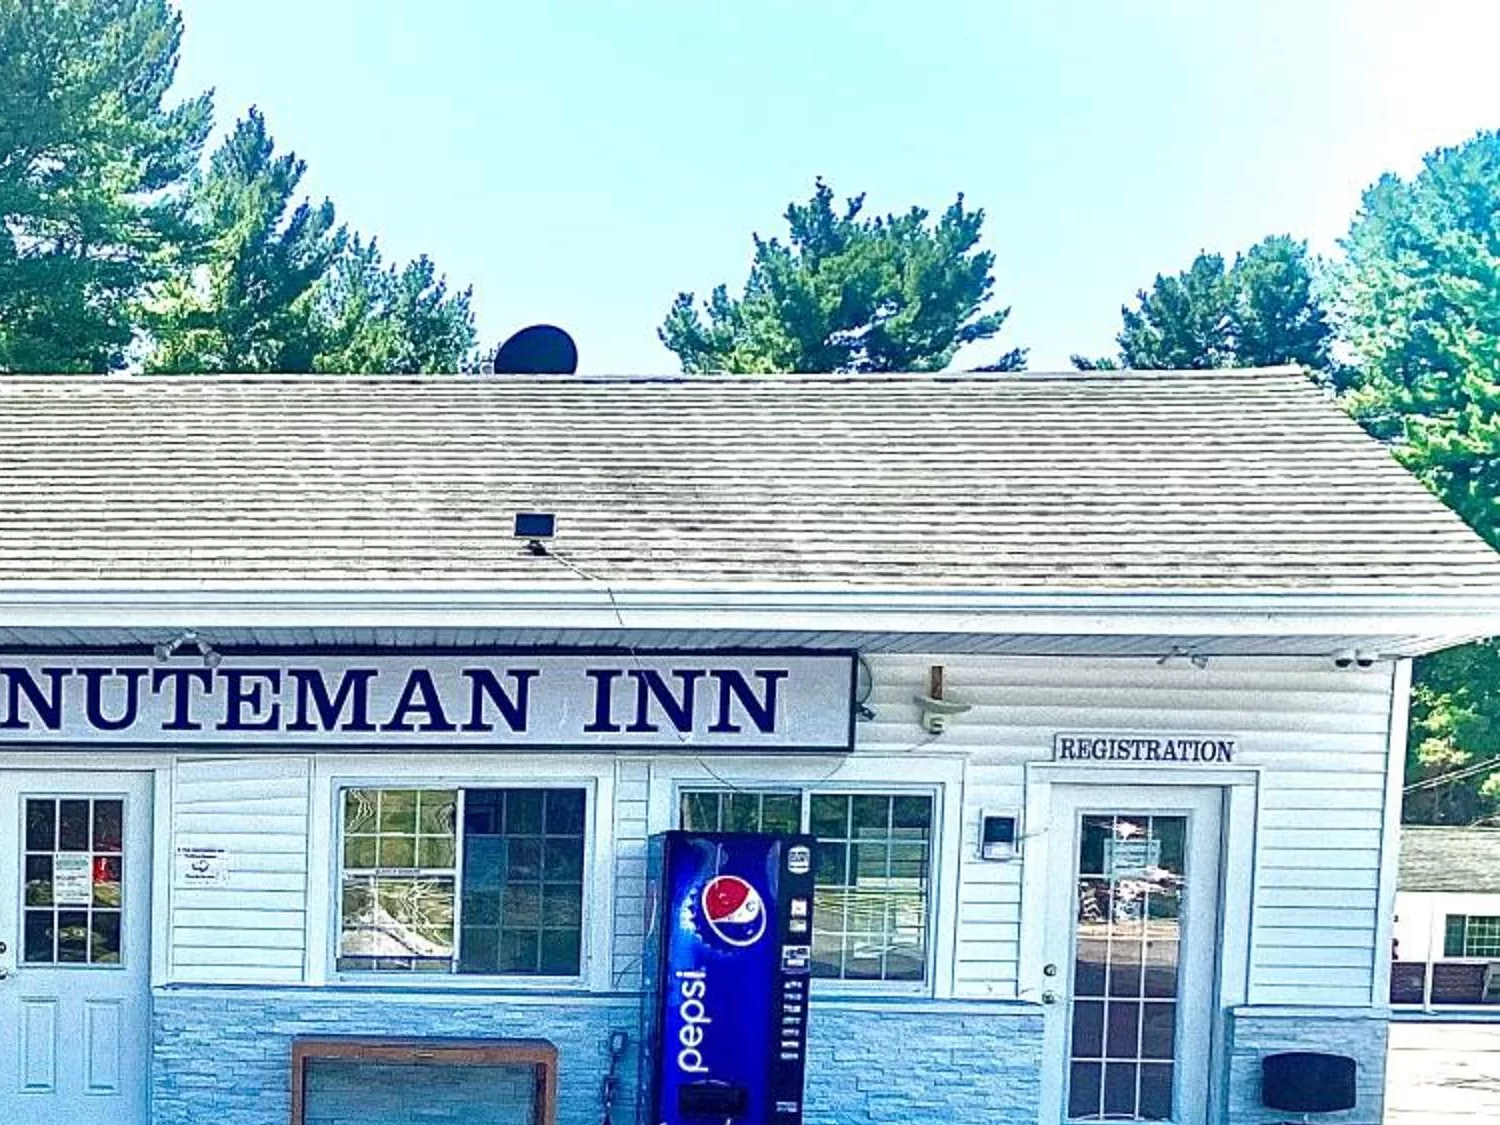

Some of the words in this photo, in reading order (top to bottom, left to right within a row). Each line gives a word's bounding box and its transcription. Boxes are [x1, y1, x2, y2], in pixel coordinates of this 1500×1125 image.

[583, 668, 789, 733] INN
[1059, 738, 1235, 762] REGISTRATION
[675, 970, 712, 1073] pepsi
